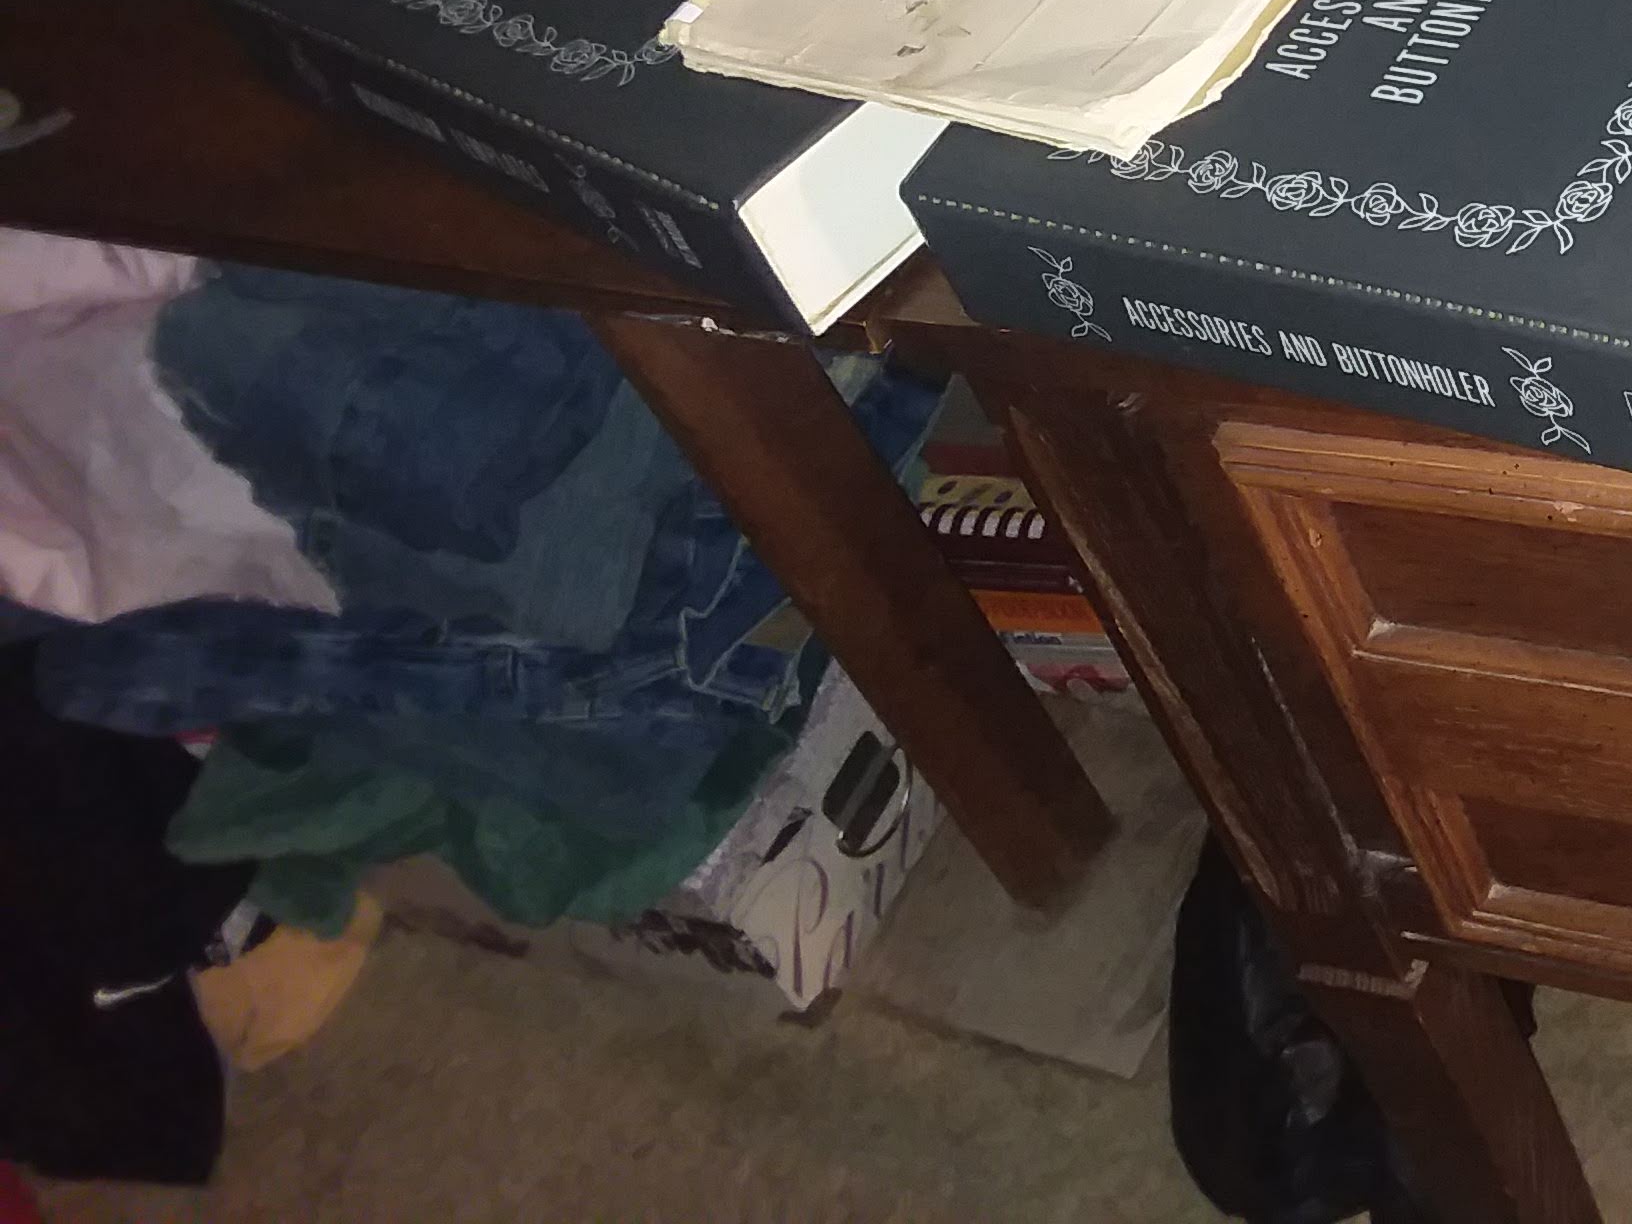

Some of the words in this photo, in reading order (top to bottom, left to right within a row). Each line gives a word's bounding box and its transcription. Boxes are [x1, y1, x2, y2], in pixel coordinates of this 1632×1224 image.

[1122, 296, 1273, 356] ACCESSORIES
[1277, 330, 1328, 368] AND
[1331, 342, 1497, 408] BUTTONHOLER
